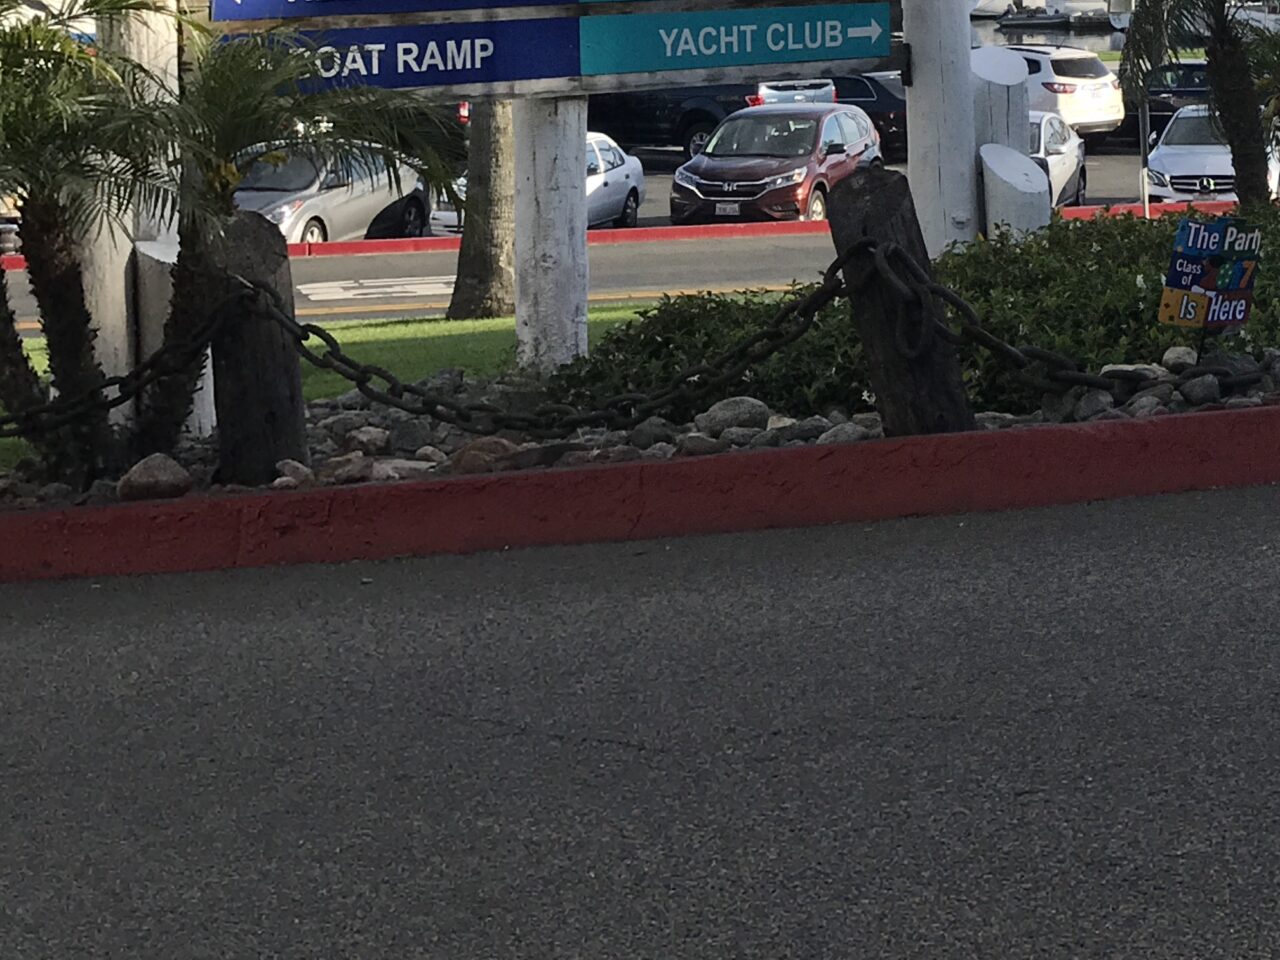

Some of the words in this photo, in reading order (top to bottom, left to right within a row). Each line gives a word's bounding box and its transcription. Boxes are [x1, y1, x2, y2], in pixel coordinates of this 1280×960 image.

[659, 24, 757, 56] YACHT
[766, 20, 843, 51] CLUB
[396, 38, 495, 73] RAMP
[1188, 222, 1220, 250] The
[1176, 259, 1201, 274] Class
[1181, 274, 1192, 286] of
[1180, 295, 1197, 320] Is
[1208, 295, 1246, 321] Here
